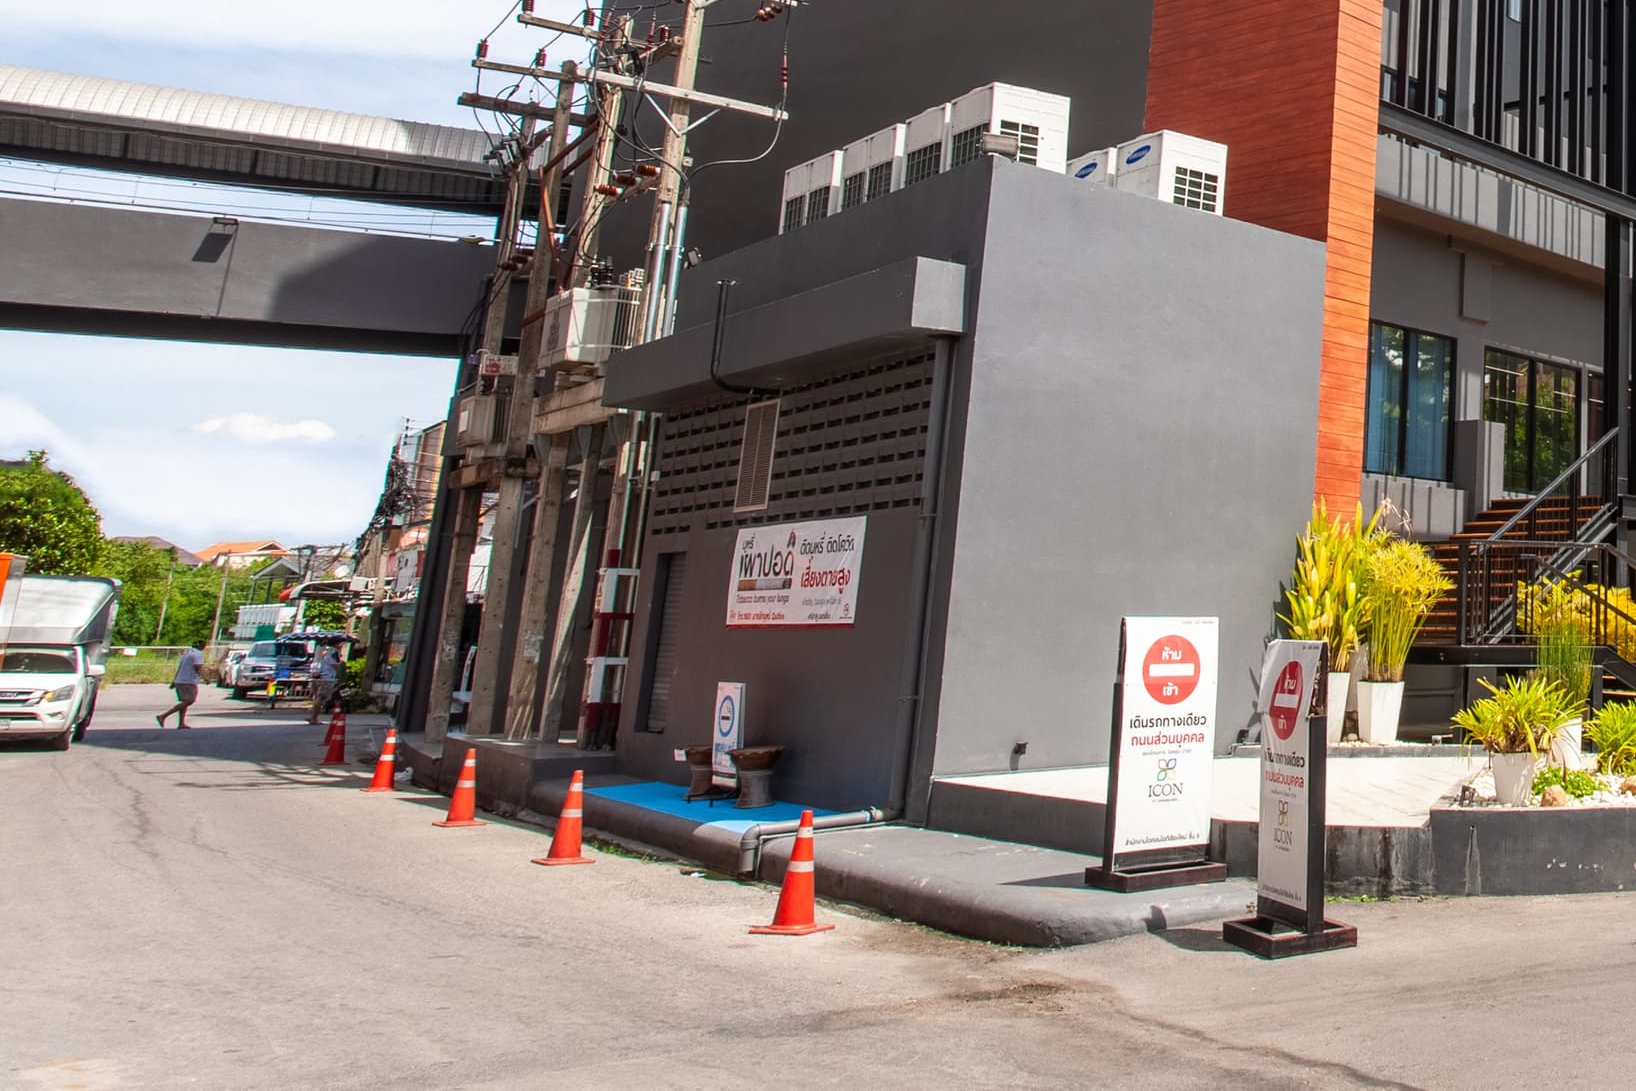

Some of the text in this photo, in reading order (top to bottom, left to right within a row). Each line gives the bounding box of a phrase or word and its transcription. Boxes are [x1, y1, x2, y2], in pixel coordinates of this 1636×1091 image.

[1162, 646, 1182, 661] ห้าม
[1163, 681, 1179, 696] เข้า
[1130, 712, 1207, 729] เดินรถทางเดียว
[1131, 731, 1205, 748] ถนนส่วนบุคคล
[1148, 782, 1183, 798] ICON
[1273, 828, 1293, 847] ICON
